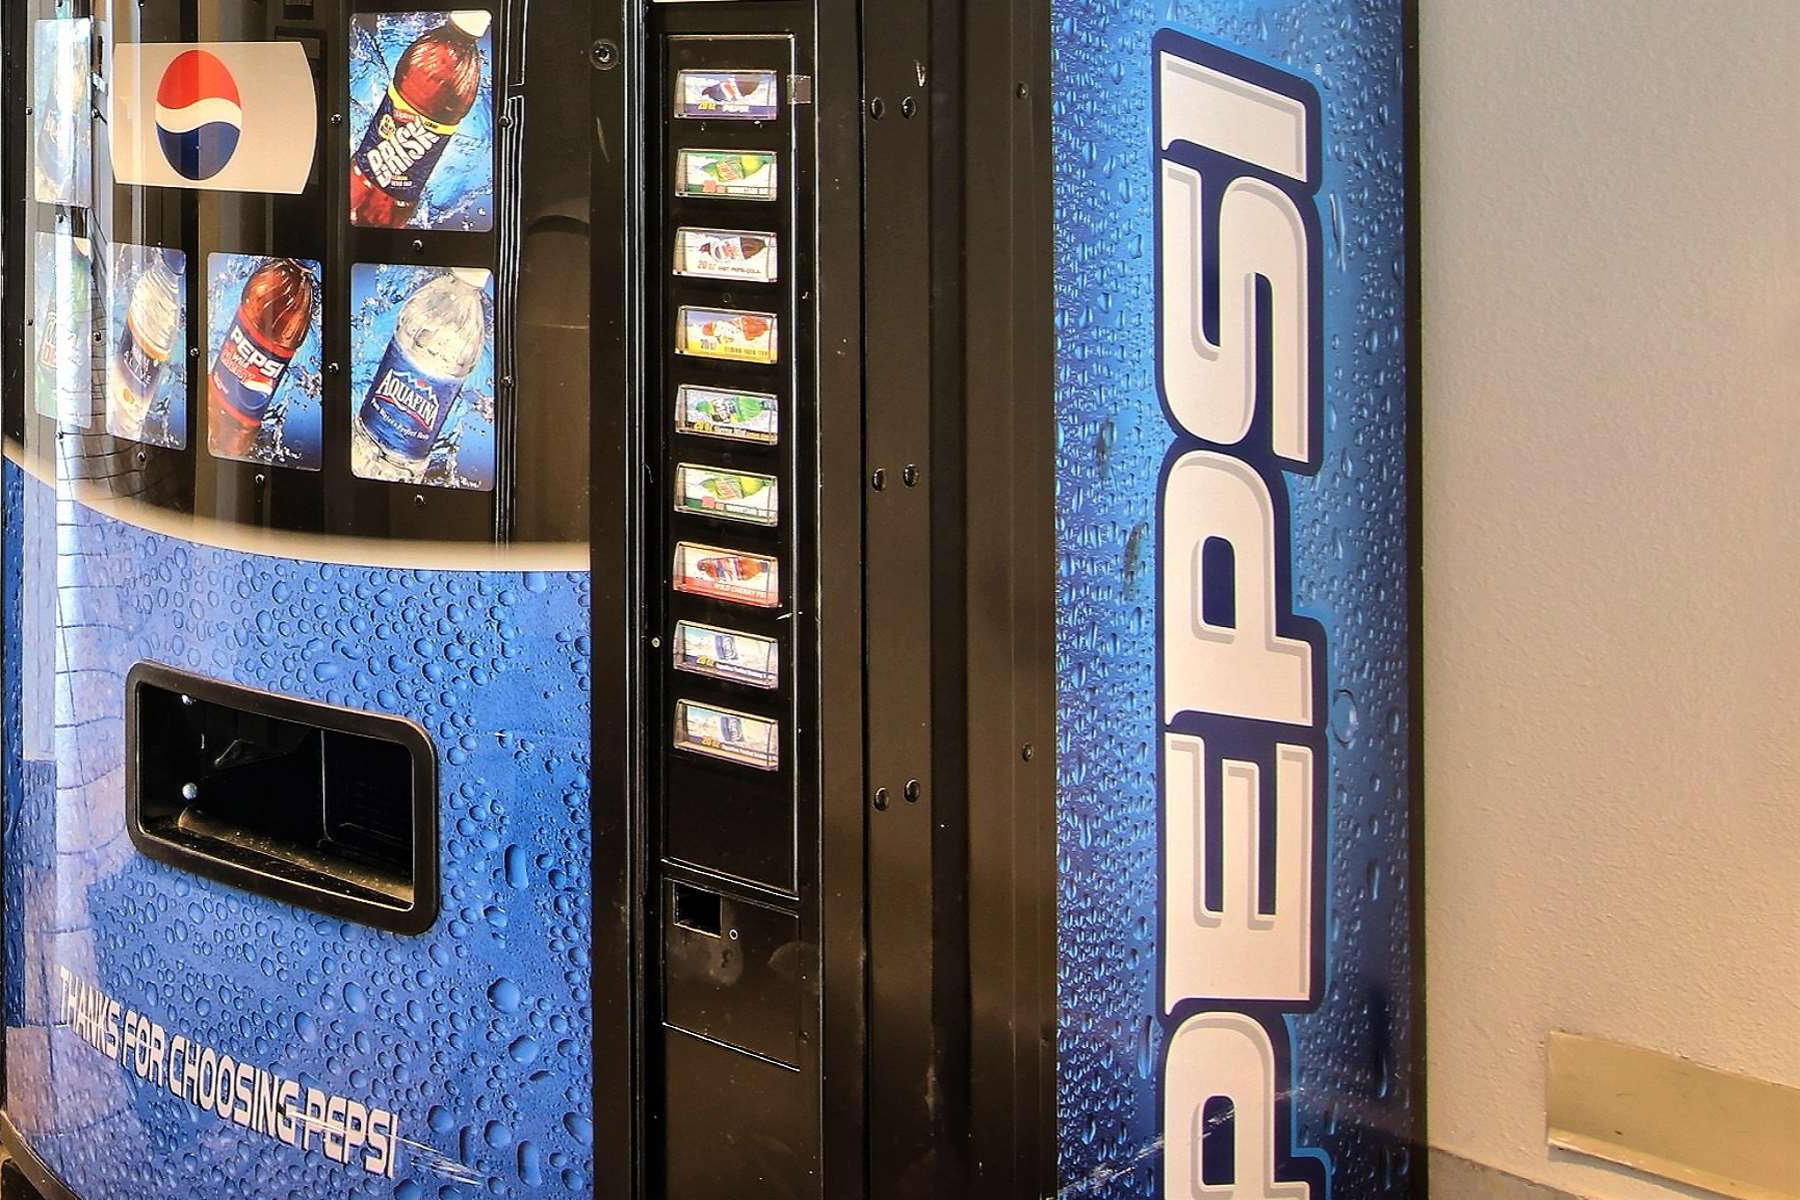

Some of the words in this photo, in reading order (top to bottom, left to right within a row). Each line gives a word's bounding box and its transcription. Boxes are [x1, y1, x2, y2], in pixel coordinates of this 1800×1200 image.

[367, 116, 441, 188] BRISK
[231, 326, 286, 380] PEPSI
[375, 372, 439, 430] AQUAFINA
[1155, 46, 1320, 1200] PEPSI
[60, 966, 120, 1060] THANKS
[122, 1008, 165, 1088] FOR
[169, 1038, 301, 1146] CHOOSING
[303, 1087, 398, 1179] PEPSI
